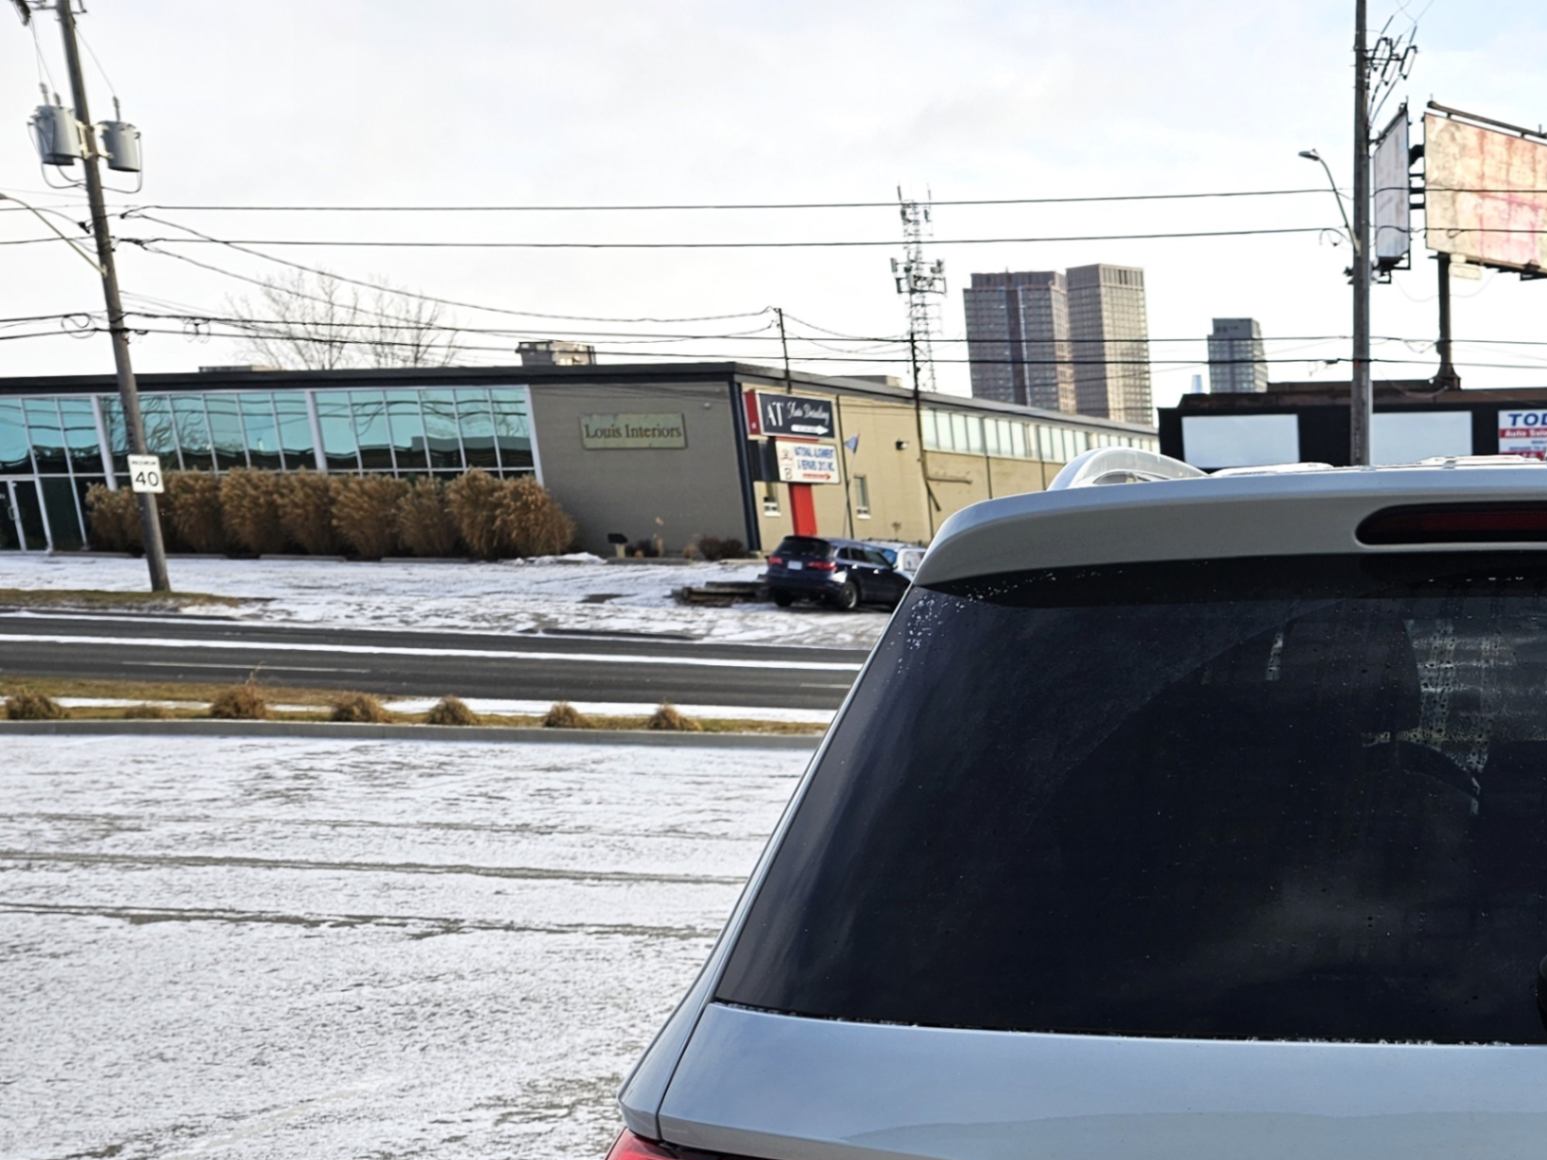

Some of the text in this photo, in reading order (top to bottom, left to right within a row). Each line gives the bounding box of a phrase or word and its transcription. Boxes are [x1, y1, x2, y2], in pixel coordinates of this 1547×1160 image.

[584, 423, 683, 439] Louis Interiors
[135, 471, 160, 487] 40
